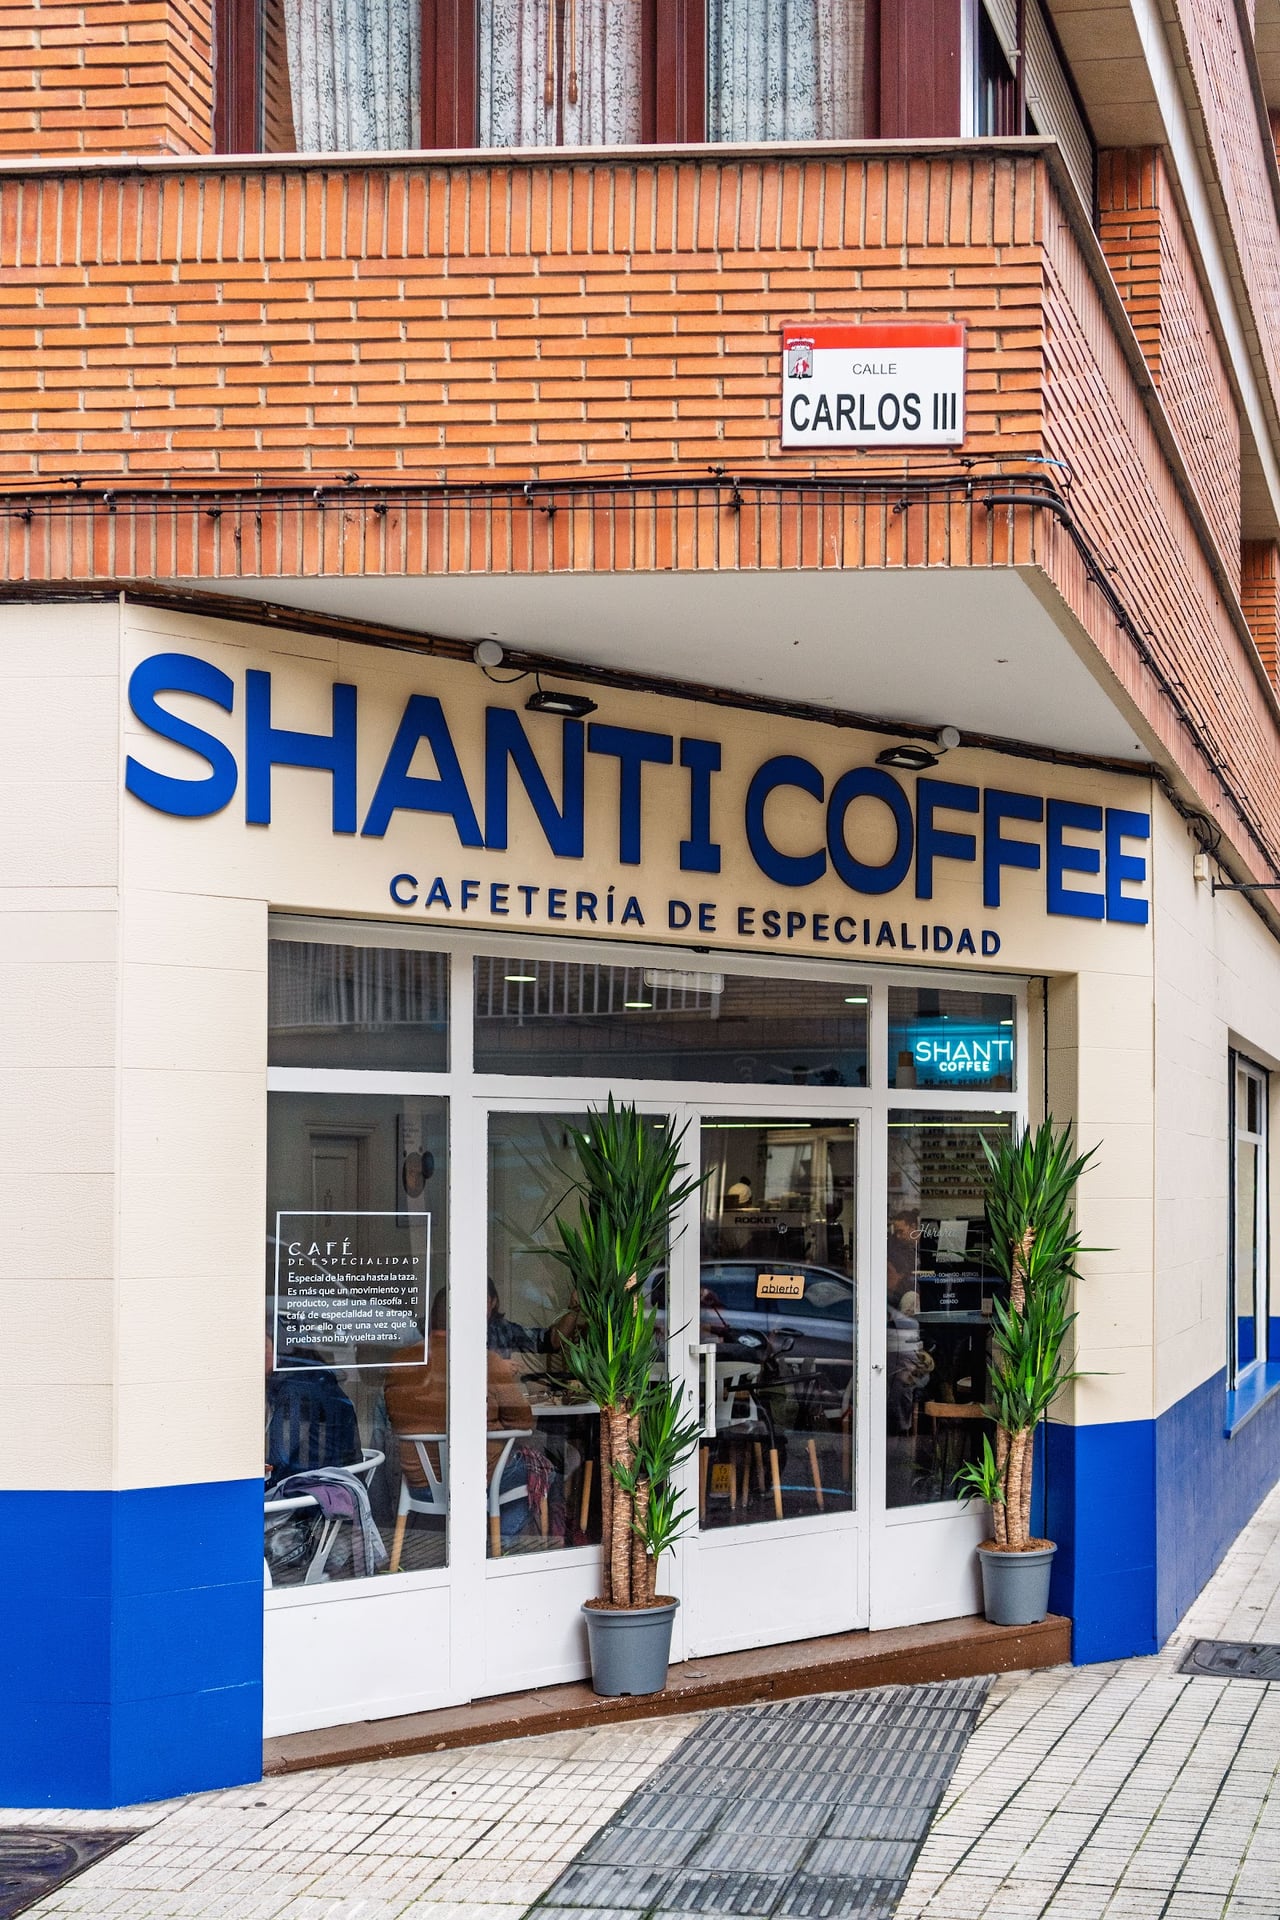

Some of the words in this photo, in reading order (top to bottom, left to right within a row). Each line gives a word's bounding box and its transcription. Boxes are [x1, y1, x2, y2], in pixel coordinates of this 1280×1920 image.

[852, 363, 897, 375] CALLE
[790, 392, 922, 431] CARLOS
[933, 392, 957, 430] III
[125, 652, 721, 874] SHANTI
[745, 755, 1150, 925] COFFEE
[389, 872, 645, 926] CAFETERÍA
[668, 900, 716, 931] DE
[737, 906, 1001, 957] ESPECIALIDAD
[916, 1040, 1014, 1062] SHANTI
[939, 1061, 990, 1072] COFFEE
[734, 1216, 778, 1225] ROCKET
[288, 1237, 353, 1256] CAFÉ
[288, 1258, 305, 1266] DE
[311, 1256, 419, 1266] ESPECIALIDAD
[288, 1272, 324, 1284] Especial
[325, 1273, 336, 1282] de
[337, 1273, 345, 1282] la
[345, 1273, 365, 1282] finca
[366, 1273, 389, 1282] hasta
[390, 1273, 397, 1281] la
[398, 1273, 418, 1281] taza.
[287, 1287, 297, 1296] Es
[299, 1286, 317, 1295] más
[318, 1287, 335, 1297] que
[337, 1287, 348, 1295] un
[350, 1286, 400, 1295] movimiento
[401, 1287, 406, 1296] y
[407, 1286, 418, 1294] un
[761, 1283, 800, 1294] abierto
[287, 1299, 330, 1310] producto,
[332, 1298, 349, 1307] casi
[351, 1298, 367, 1306] una
[410, 1296, 418, 1305] El
[286, 1310, 306, 1320] café
[307, 1310, 319, 1319] de
[321, 1309, 373, 1321] especialidad
[386, 1309, 413, 1319] atrapa
[299, 1324, 315, 1334] por
[317, 1322, 334, 1331] ello
[336, 1322, 353, 1333] que
[355, 1322, 371, 1330] una
[373, 1321, 388, 1329] vez
[391, 1321, 407, 1330] que
[409, 1319, 418, 1328] lo
[286, 1334, 321, 1346] pruebas
[334, 1332, 350, 1343] hay
[350, 1332, 376, 1341] vuelta
